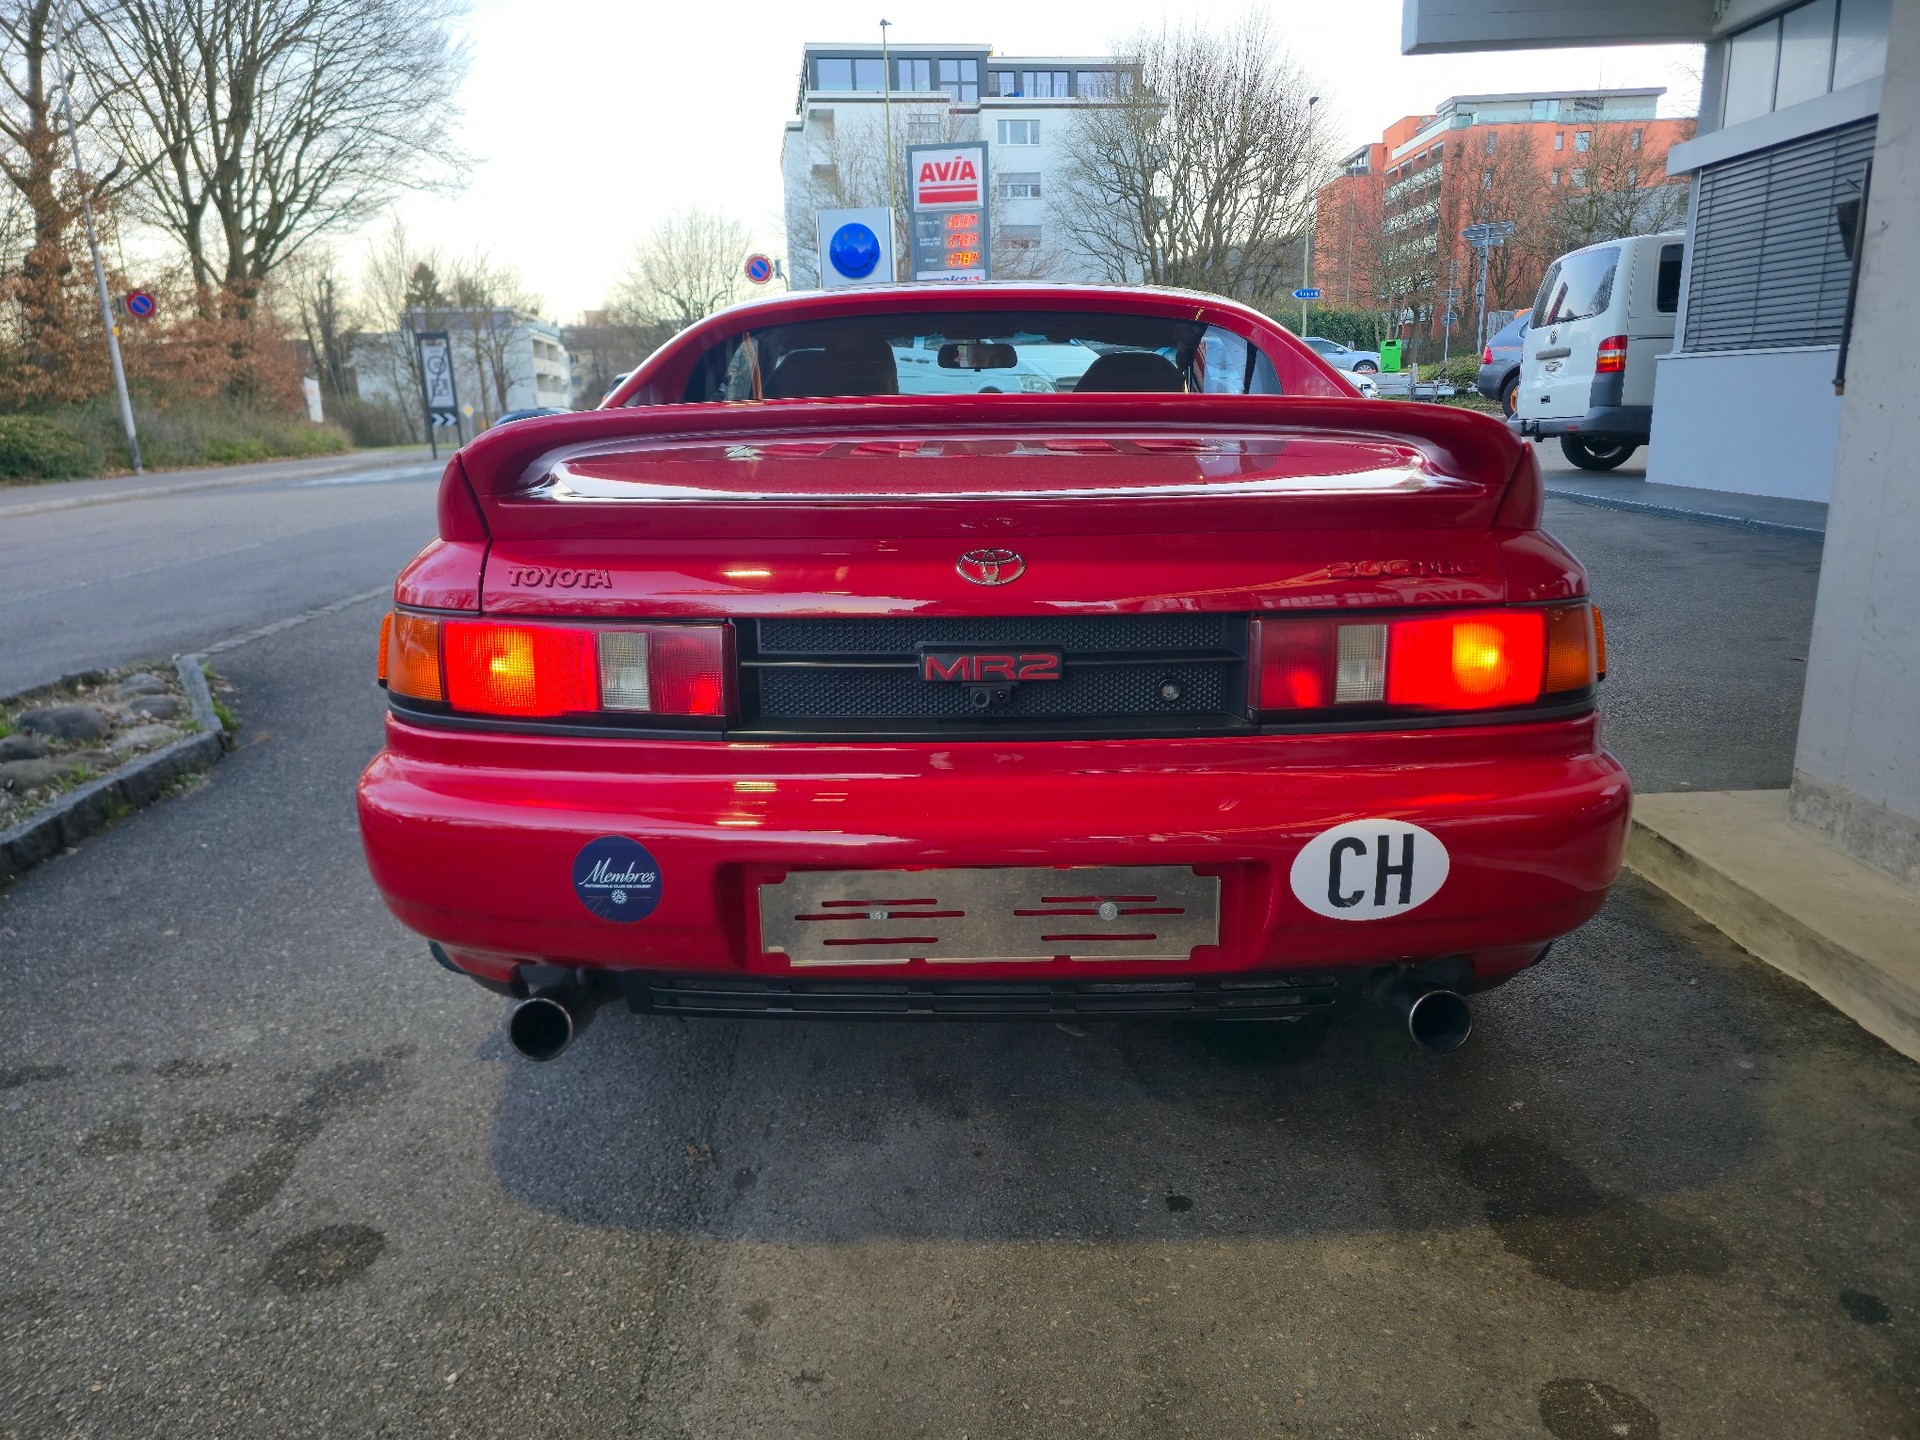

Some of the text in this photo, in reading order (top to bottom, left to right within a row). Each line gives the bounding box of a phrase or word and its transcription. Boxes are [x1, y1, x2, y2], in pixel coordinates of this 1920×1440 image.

[508, 567, 612, 588] TOYOTA
[925, 655, 1059, 681] MR2
[579, 857, 656, 884] Membres
[1328, 833, 1414, 908] CH
